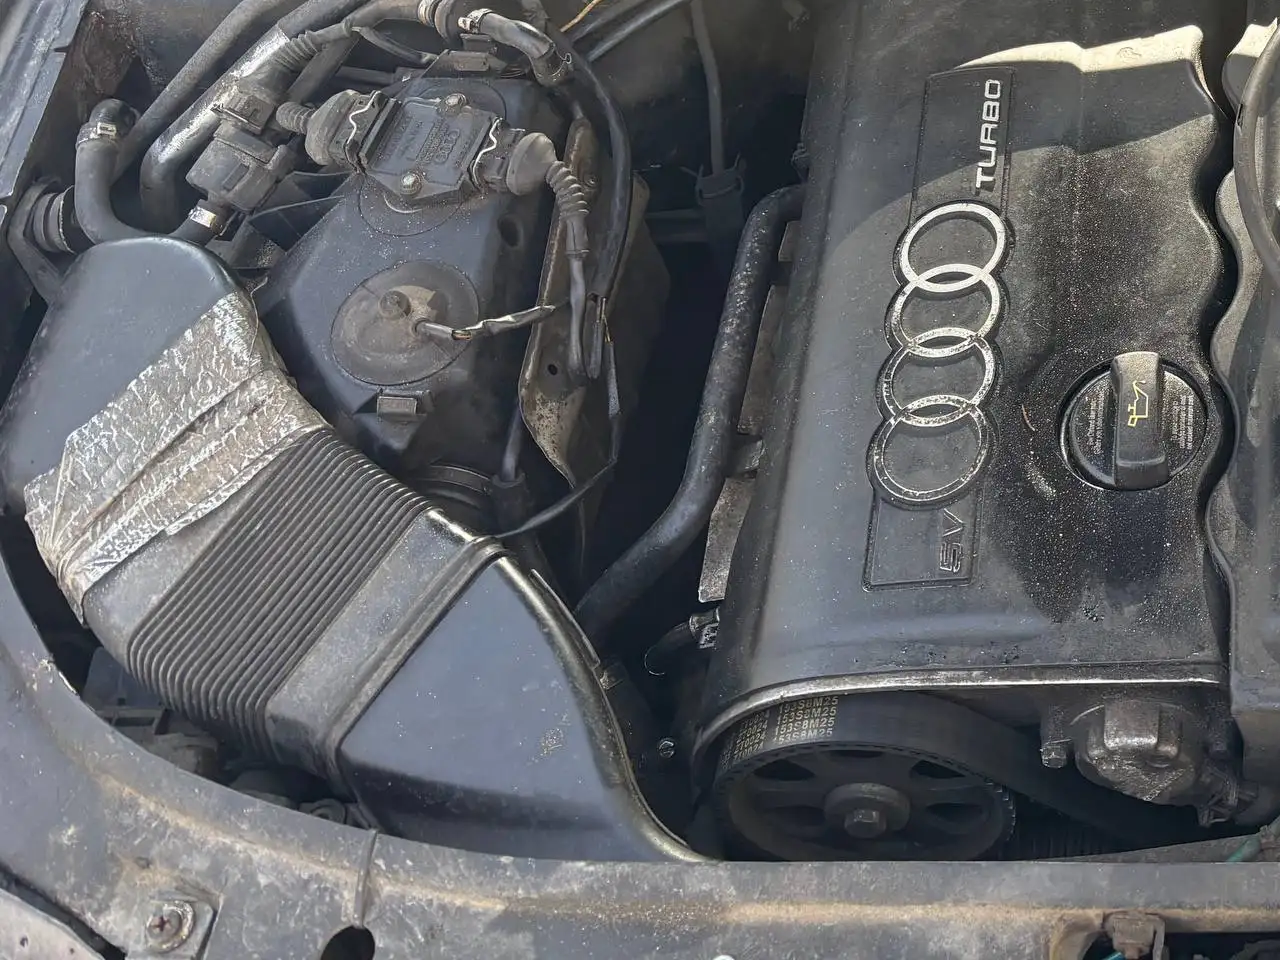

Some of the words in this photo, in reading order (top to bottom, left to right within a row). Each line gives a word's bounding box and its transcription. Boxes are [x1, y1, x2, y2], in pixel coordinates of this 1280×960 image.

[975, 79, 1001, 189] TURBO
[940, 507, 964, 573] 5V
[779, 696, 839, 714] 153S8M25
[777, 707, 837, 725] 153S8M25
[775, 718, 835, 735] 153S8M25
